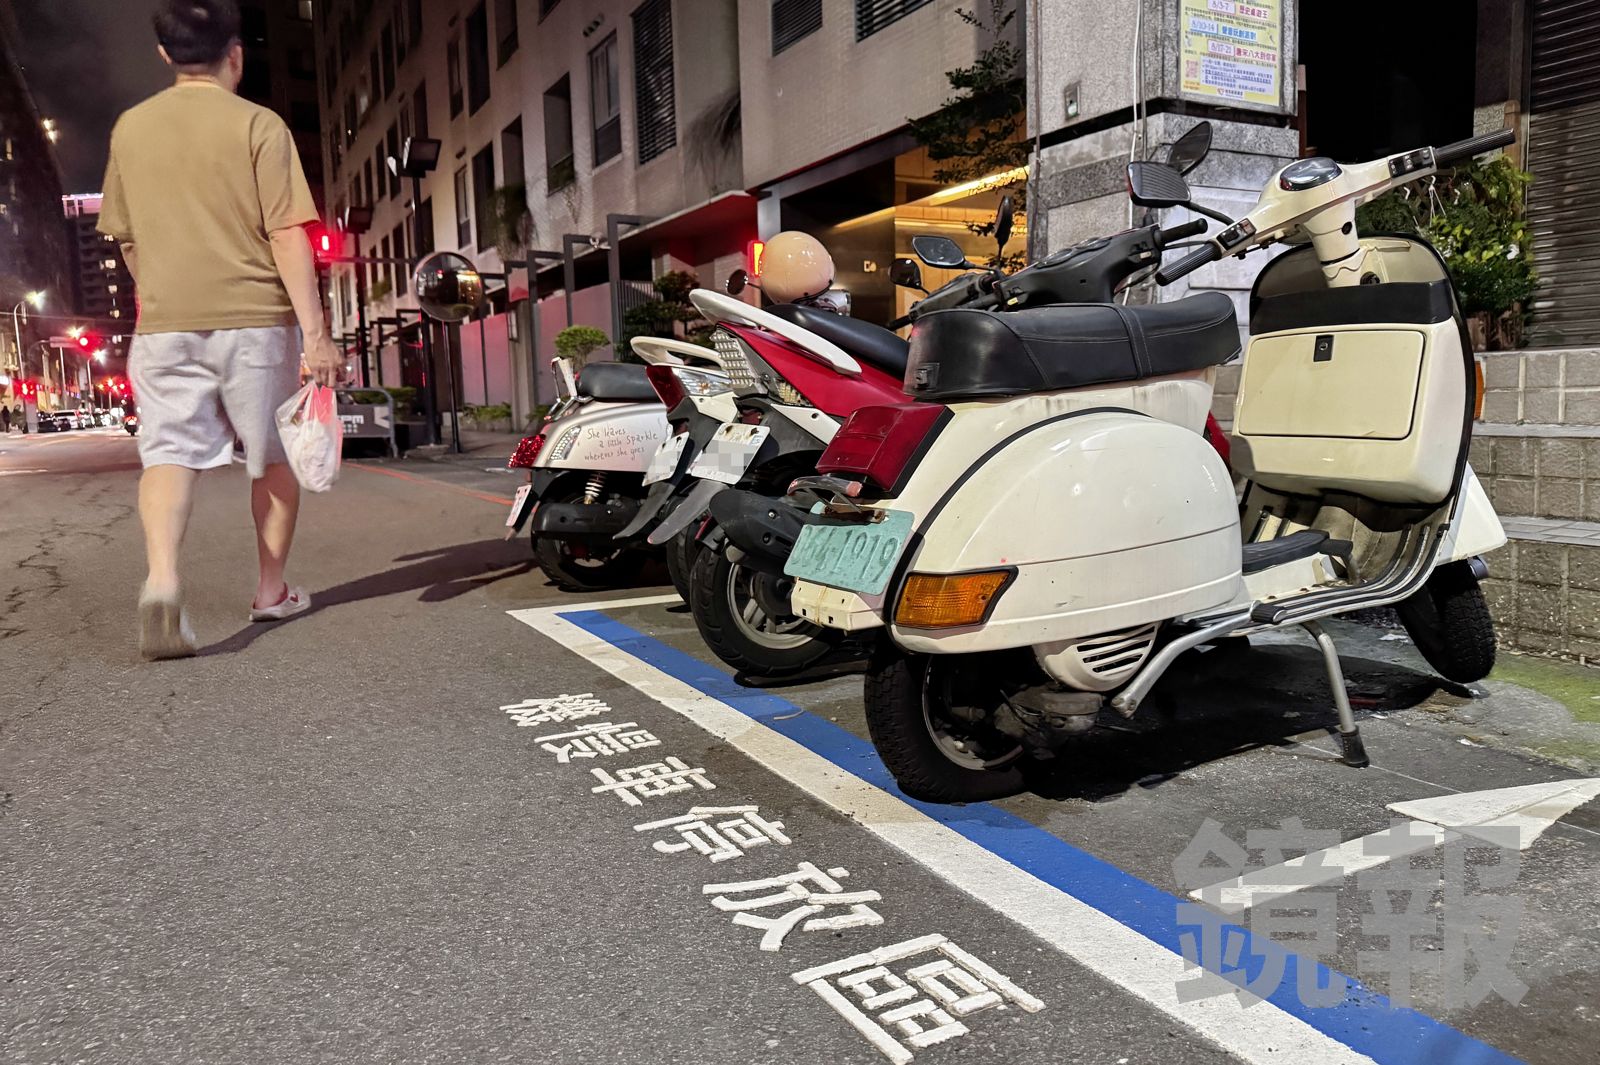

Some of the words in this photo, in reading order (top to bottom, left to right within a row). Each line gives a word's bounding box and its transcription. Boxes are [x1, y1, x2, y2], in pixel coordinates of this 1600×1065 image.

[587, 428, 600, 439] She
[604, 426, 626, 437] leaves
[584, 452, 614, 461] wherever
[616, 448, 627, 456] she
[630, 446, 645, 461] goes
[499, 692, 1047, 1065] 機慢車停放區
